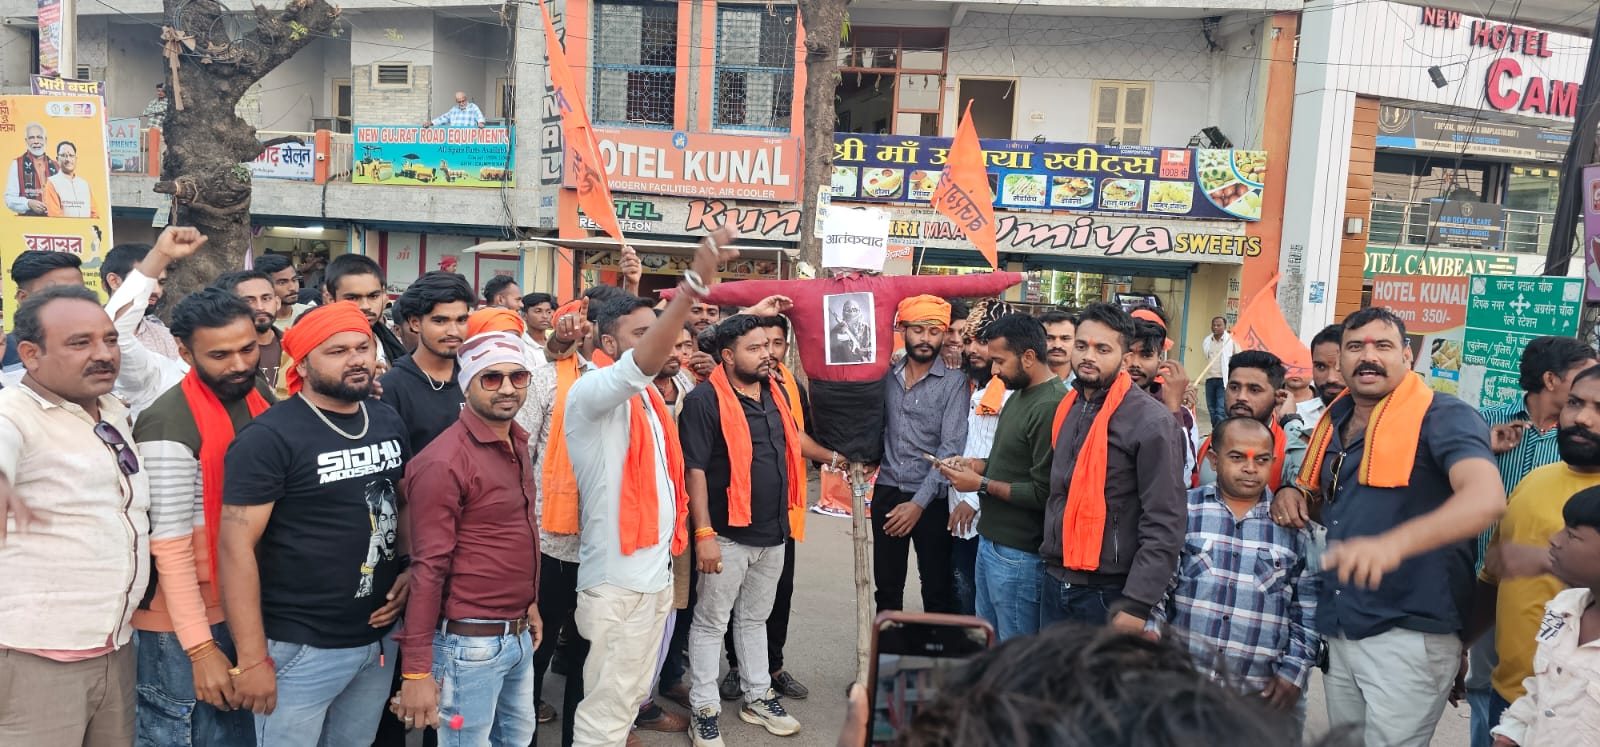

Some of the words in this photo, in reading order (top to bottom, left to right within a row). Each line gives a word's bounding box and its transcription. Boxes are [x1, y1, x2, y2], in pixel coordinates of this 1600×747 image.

[1422, 6, 1463, 29] NEW
[1471, 20, 1552, 58] HOTEL
[1486, 57, 1579, 118] CAM
[358, 128, 379, 143] NEW
[381, 128, 417, 144] GUJRAT
[420, 128, 445, 144] ROAD
[599, 139, 674, 179] OTEL
[683, 146, 790, 186] KUNAL
[1043, 148, 1159, 177] स्वीट्स
[608, 180, 647, 191] MODERN
[649, 183, 697, 193] FACILITIES
[719, 188, 734, 196] AIR
[737, 188, 775, 199] COOLER
[826, 232, 884, 248] आतंकवाद
[1175, 233, 1263, 257] SWEETS
[1363, 251, 1401, 274] TEL
[1405, 254, 1486, 276] CAMBEAN
[1374, 281, 1416, 302] HOTEL
[1420, 282, 1467, 305] KUNAL
[1422, 308, 1451, 324] 350/-
[1492, 300, 1505, 311] नगर
[1518, 314, 1538, 329] स्टेशन
[317, 440, 401, 475] SIDHU
